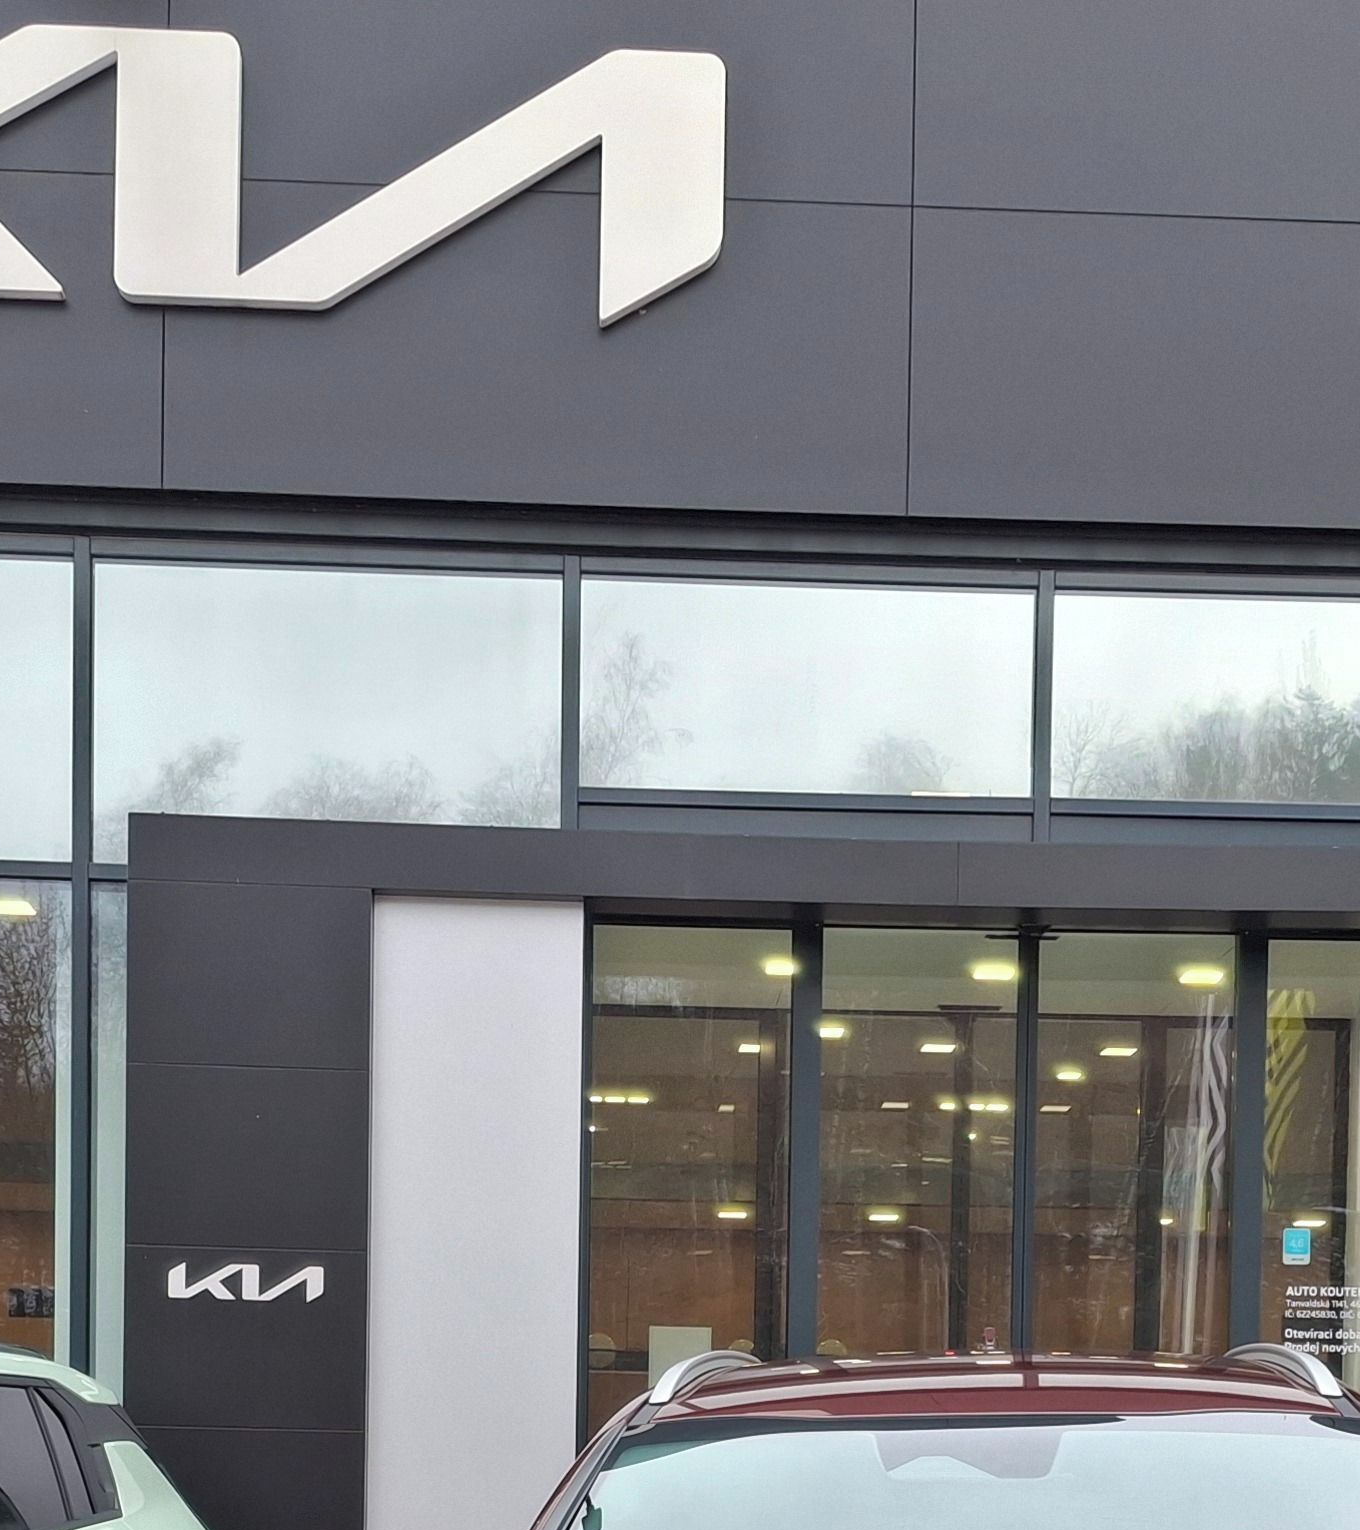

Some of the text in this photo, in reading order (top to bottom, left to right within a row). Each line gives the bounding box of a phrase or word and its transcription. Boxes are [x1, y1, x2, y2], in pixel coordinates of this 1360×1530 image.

[166, 1262, 325, 1304] KIA
[1286, 1286, 1318, 1297] AUTO
[1284, 1342, 1320, 1356] Prodej
[1322, 1342, 1360, 1356] nových
